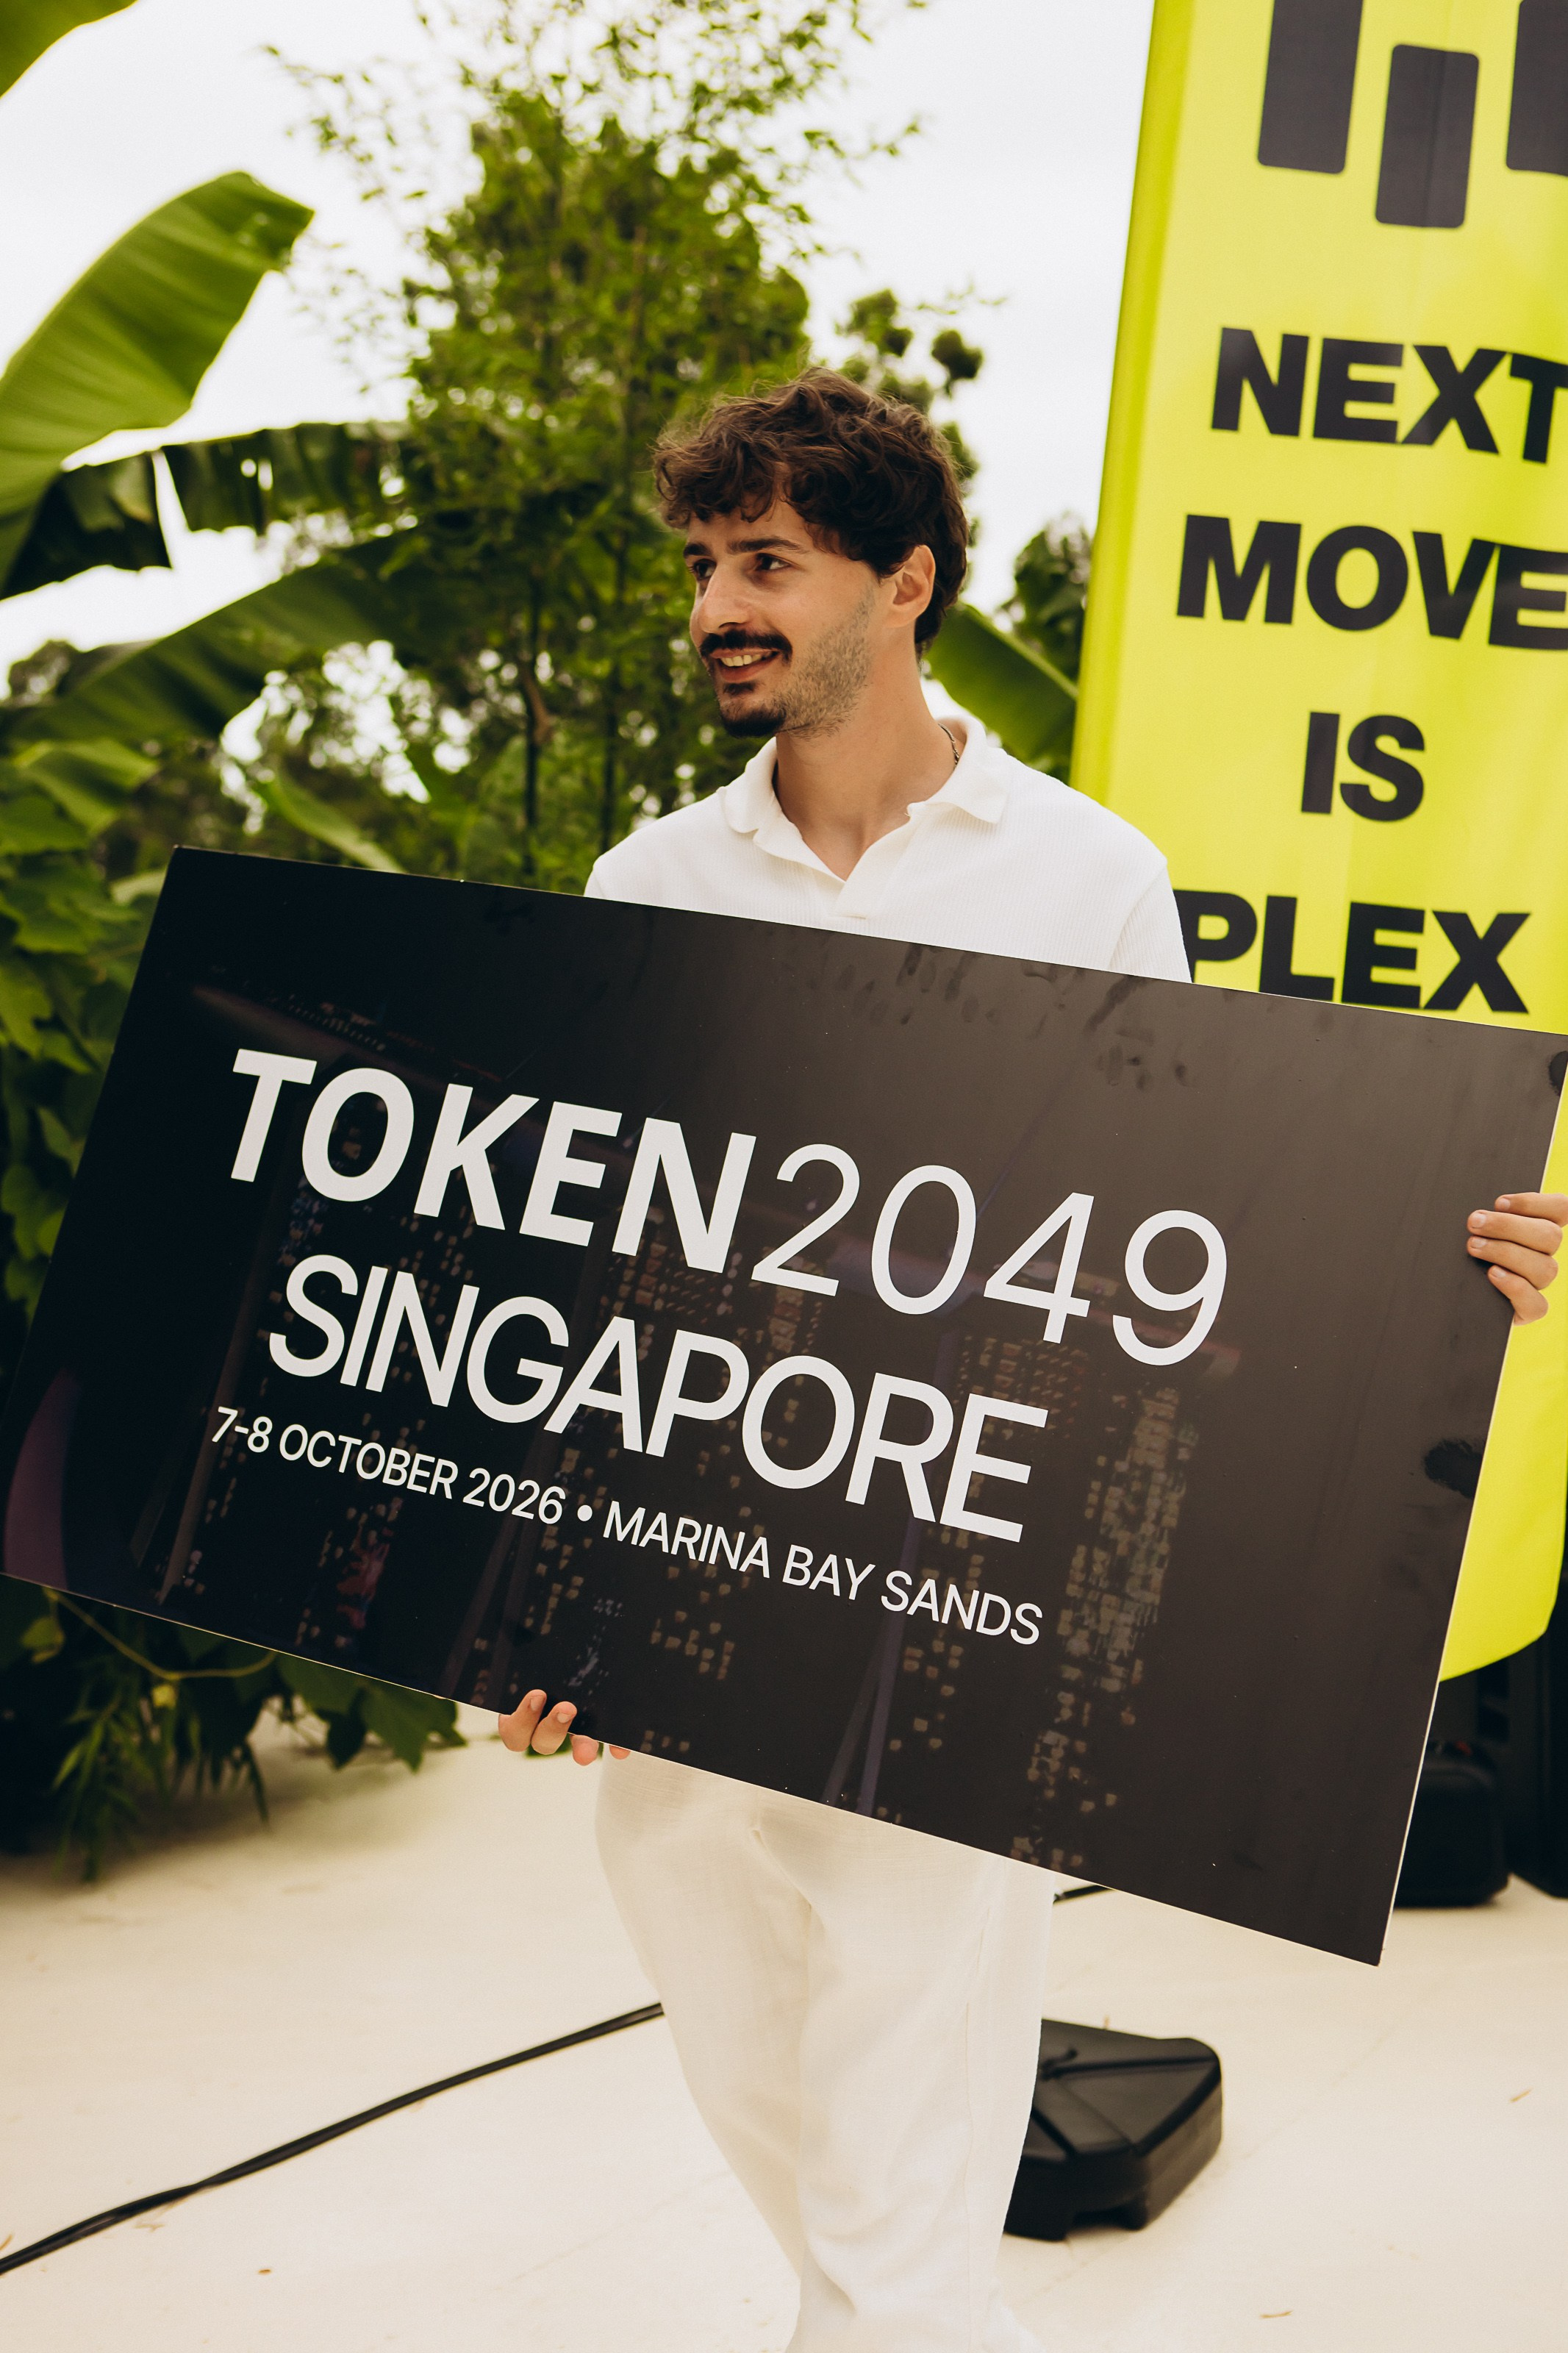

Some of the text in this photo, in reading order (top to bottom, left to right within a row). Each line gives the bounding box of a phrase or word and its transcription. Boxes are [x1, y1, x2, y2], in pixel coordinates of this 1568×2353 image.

[1210, 326, 1568, 465] NEXT
[1175, 513, 1568, 651] MOVE
[1300, 710, 1426, 823] IS
[1171, 888, 1532, 1015] PLEX
[230, 1048, 1228, 1366] TOKEN2049
[268, 1254, 1050, 1543] SINGAPORE
[211, 1406, 1044, 1646] 7-8 OCTOBER 2026 MARINA BAY SANDS
